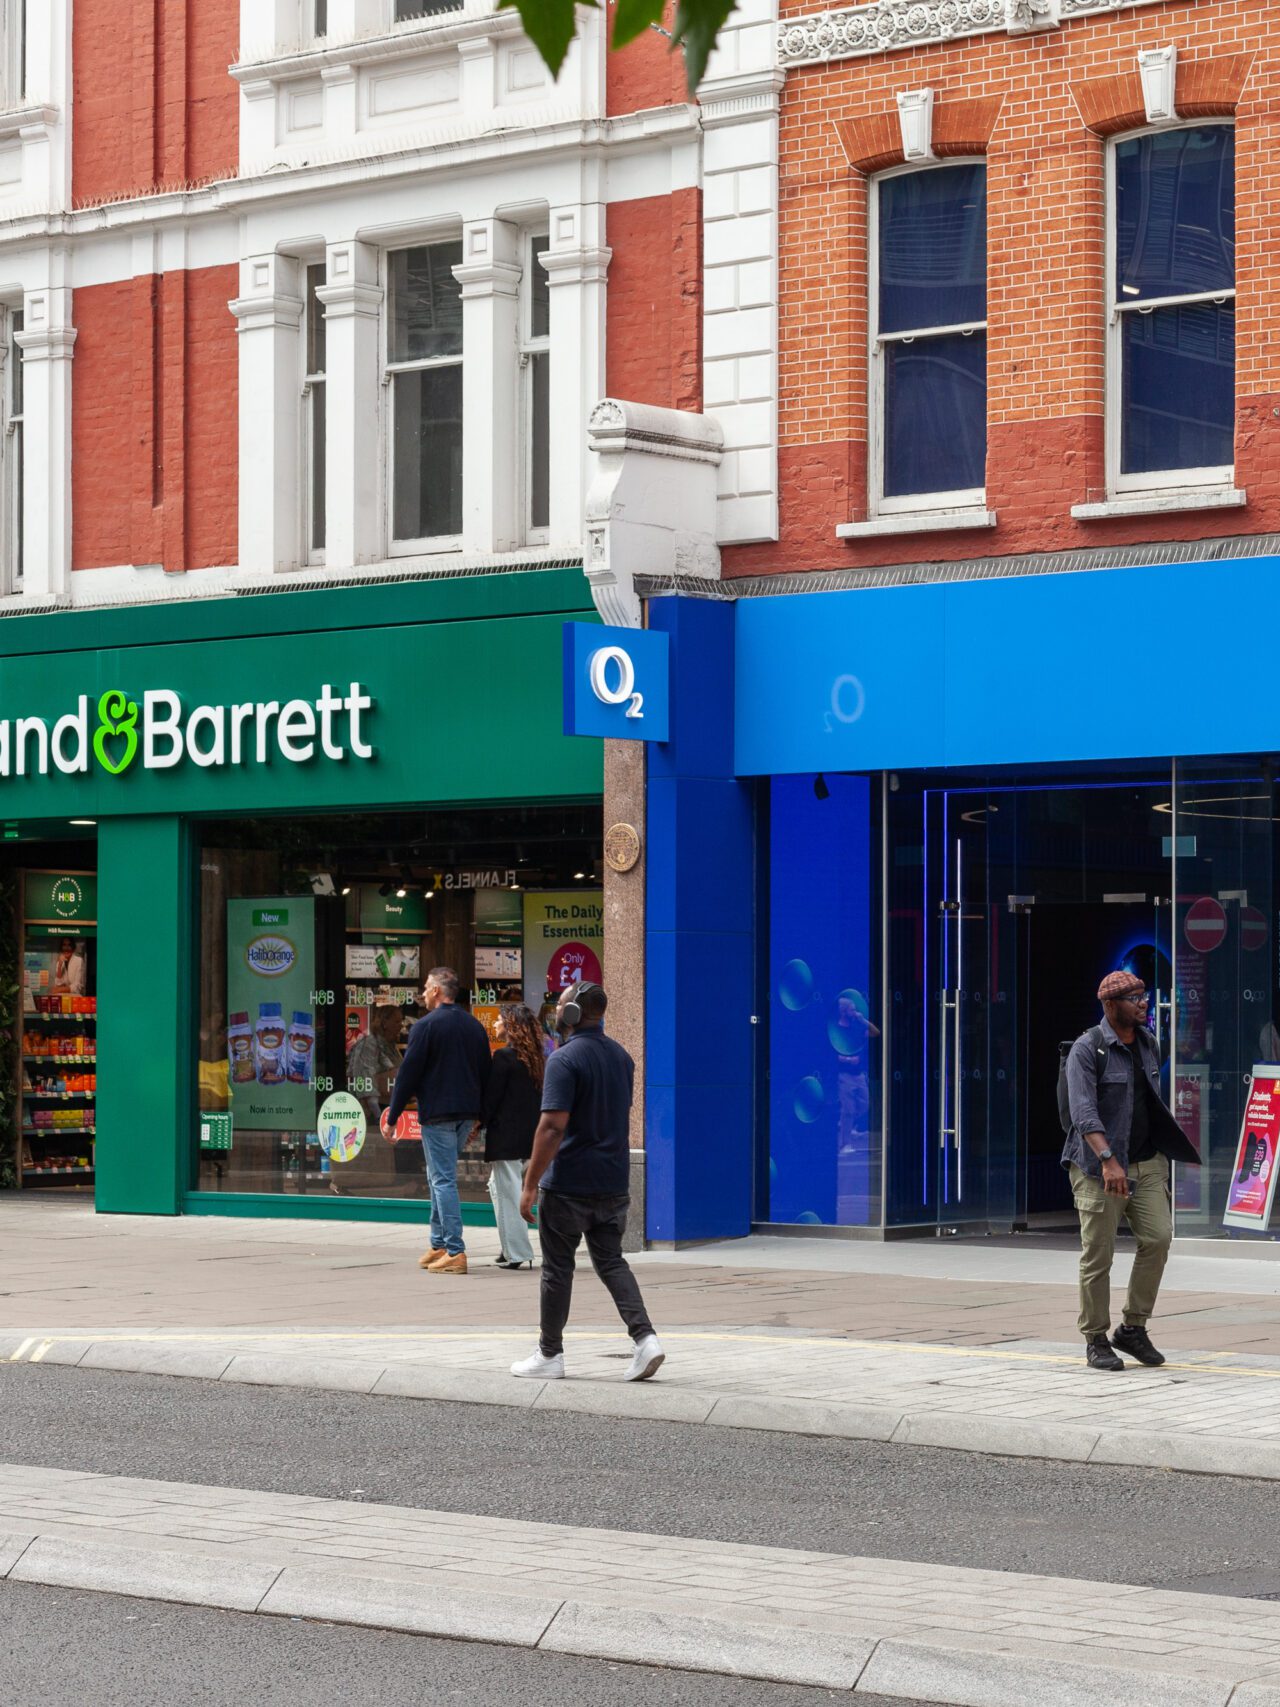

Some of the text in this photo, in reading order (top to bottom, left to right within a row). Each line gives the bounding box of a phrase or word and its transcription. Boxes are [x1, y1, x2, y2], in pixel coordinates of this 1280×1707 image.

[590, 646, 644, 718] O2
[385, 904, 403, 914] Beauty
[544, 905, 603, 922] The Daily
[261, 912, 279, 922] New
[565, 953, 585, 966] Only
[309, 990, 335, 1005] H&B
[349, 990, 374, 1005] H&B
[469, 989, 496, 1005] H&B
[309, 1076, 334, 1091] H&B
[348, 1076, 373, 1091] H&B
[250, 1105, 294, 1114] Now in store
[323, 1111, 361, 1120] summer
